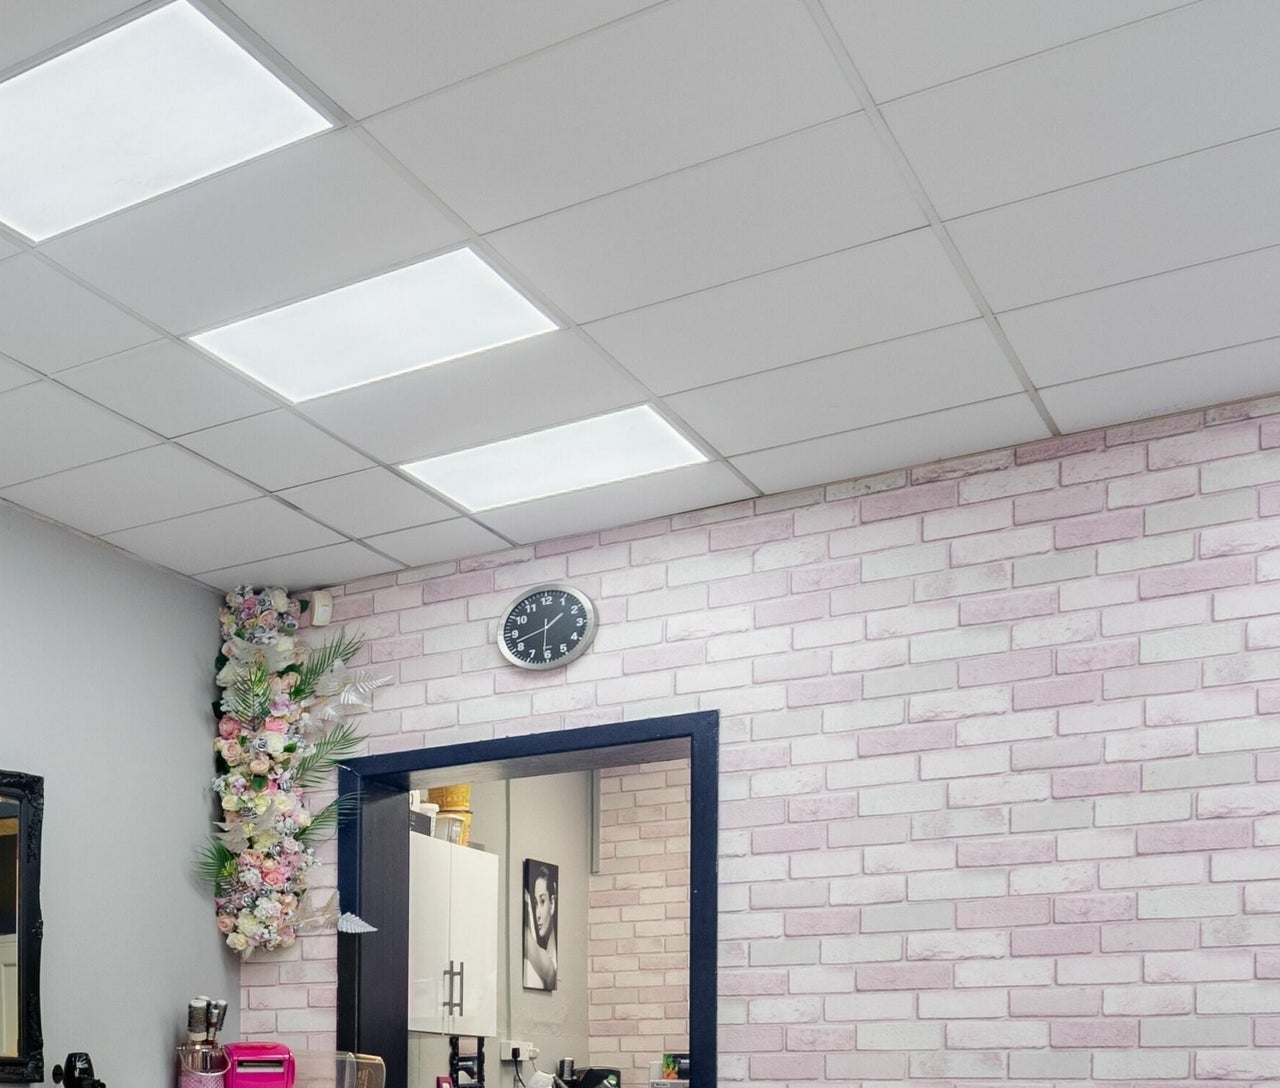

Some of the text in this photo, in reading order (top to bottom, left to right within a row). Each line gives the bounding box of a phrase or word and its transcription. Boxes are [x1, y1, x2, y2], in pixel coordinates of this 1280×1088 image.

[540, 596, 553, 606] 12
[560, 597, 566, 606] 1
[525, 603, 537, 613] 11
[570, 605, 578, 615] 2
[516, 615, 528, 625] 10
[575, 617, 584, 627] 3
[511, 629, 519, 639] 9
[570, 632, 578, 641] 4
[517, 642, 525, 651] 8
[559, 643, 568, 653] 5
[528, 649, 536, 658] 7
[544, 650, 552, 659] 6
